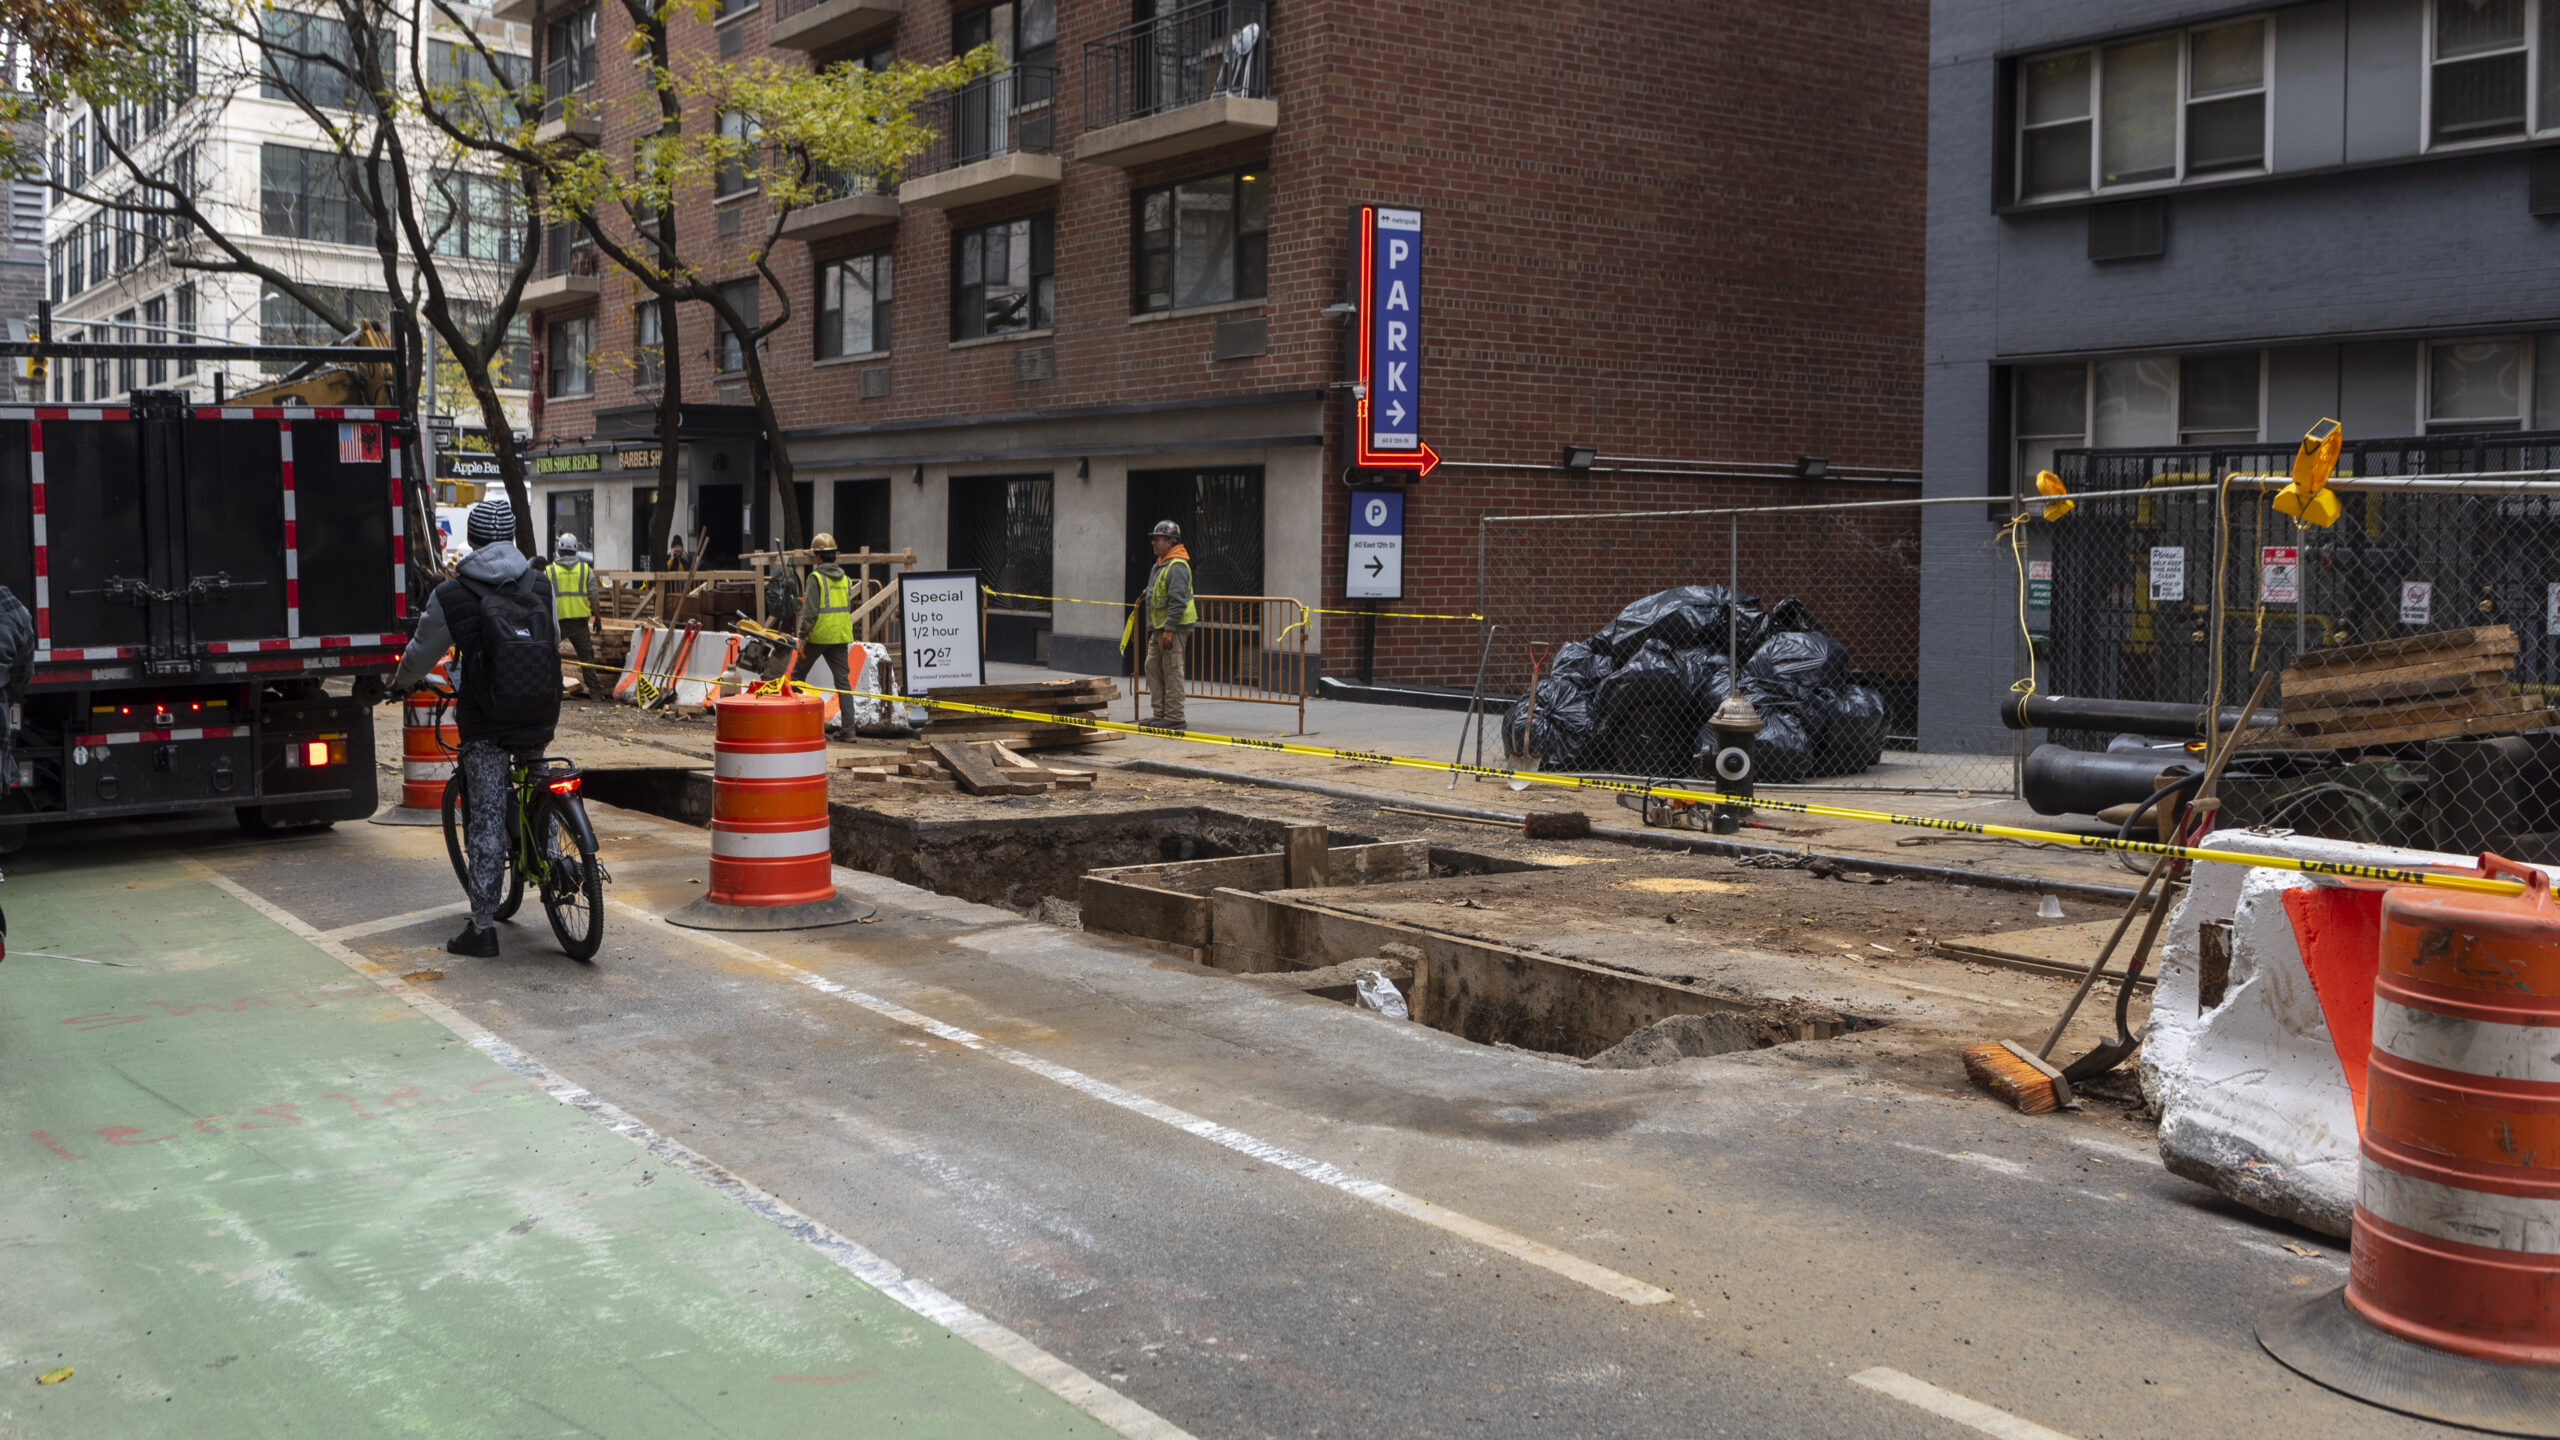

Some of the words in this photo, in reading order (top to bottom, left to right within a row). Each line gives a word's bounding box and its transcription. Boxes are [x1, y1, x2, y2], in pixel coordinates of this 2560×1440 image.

[1386, 238, 1409, 392] PARK
[553, 456, 572, 472] SHOE
[572, 454, 598, 471] REPAIR
[618, 450, 647, 467] BARBER
[650, 450, 663, 466] SH
[452, 461, 483, 475] Apple
[1371, 505, 1382, 520] P
[1354, 541, 1363, 549] 60
[1363, 541, 1376, 549] East
[1376, 541, 1388, 549] 12th
[1389, 541, 1396, 549] St
[910, 590, 963, 605] Special
[911, 612, 928, 624] Up
[931, 612, 943, 622] to
[912, 627, 929, 639] 1/2
[932, 627, 959, 637] hour
[2080, 835, 2187, 858] CAUTION
[2299, 859, 2425, 884] CAUTION
